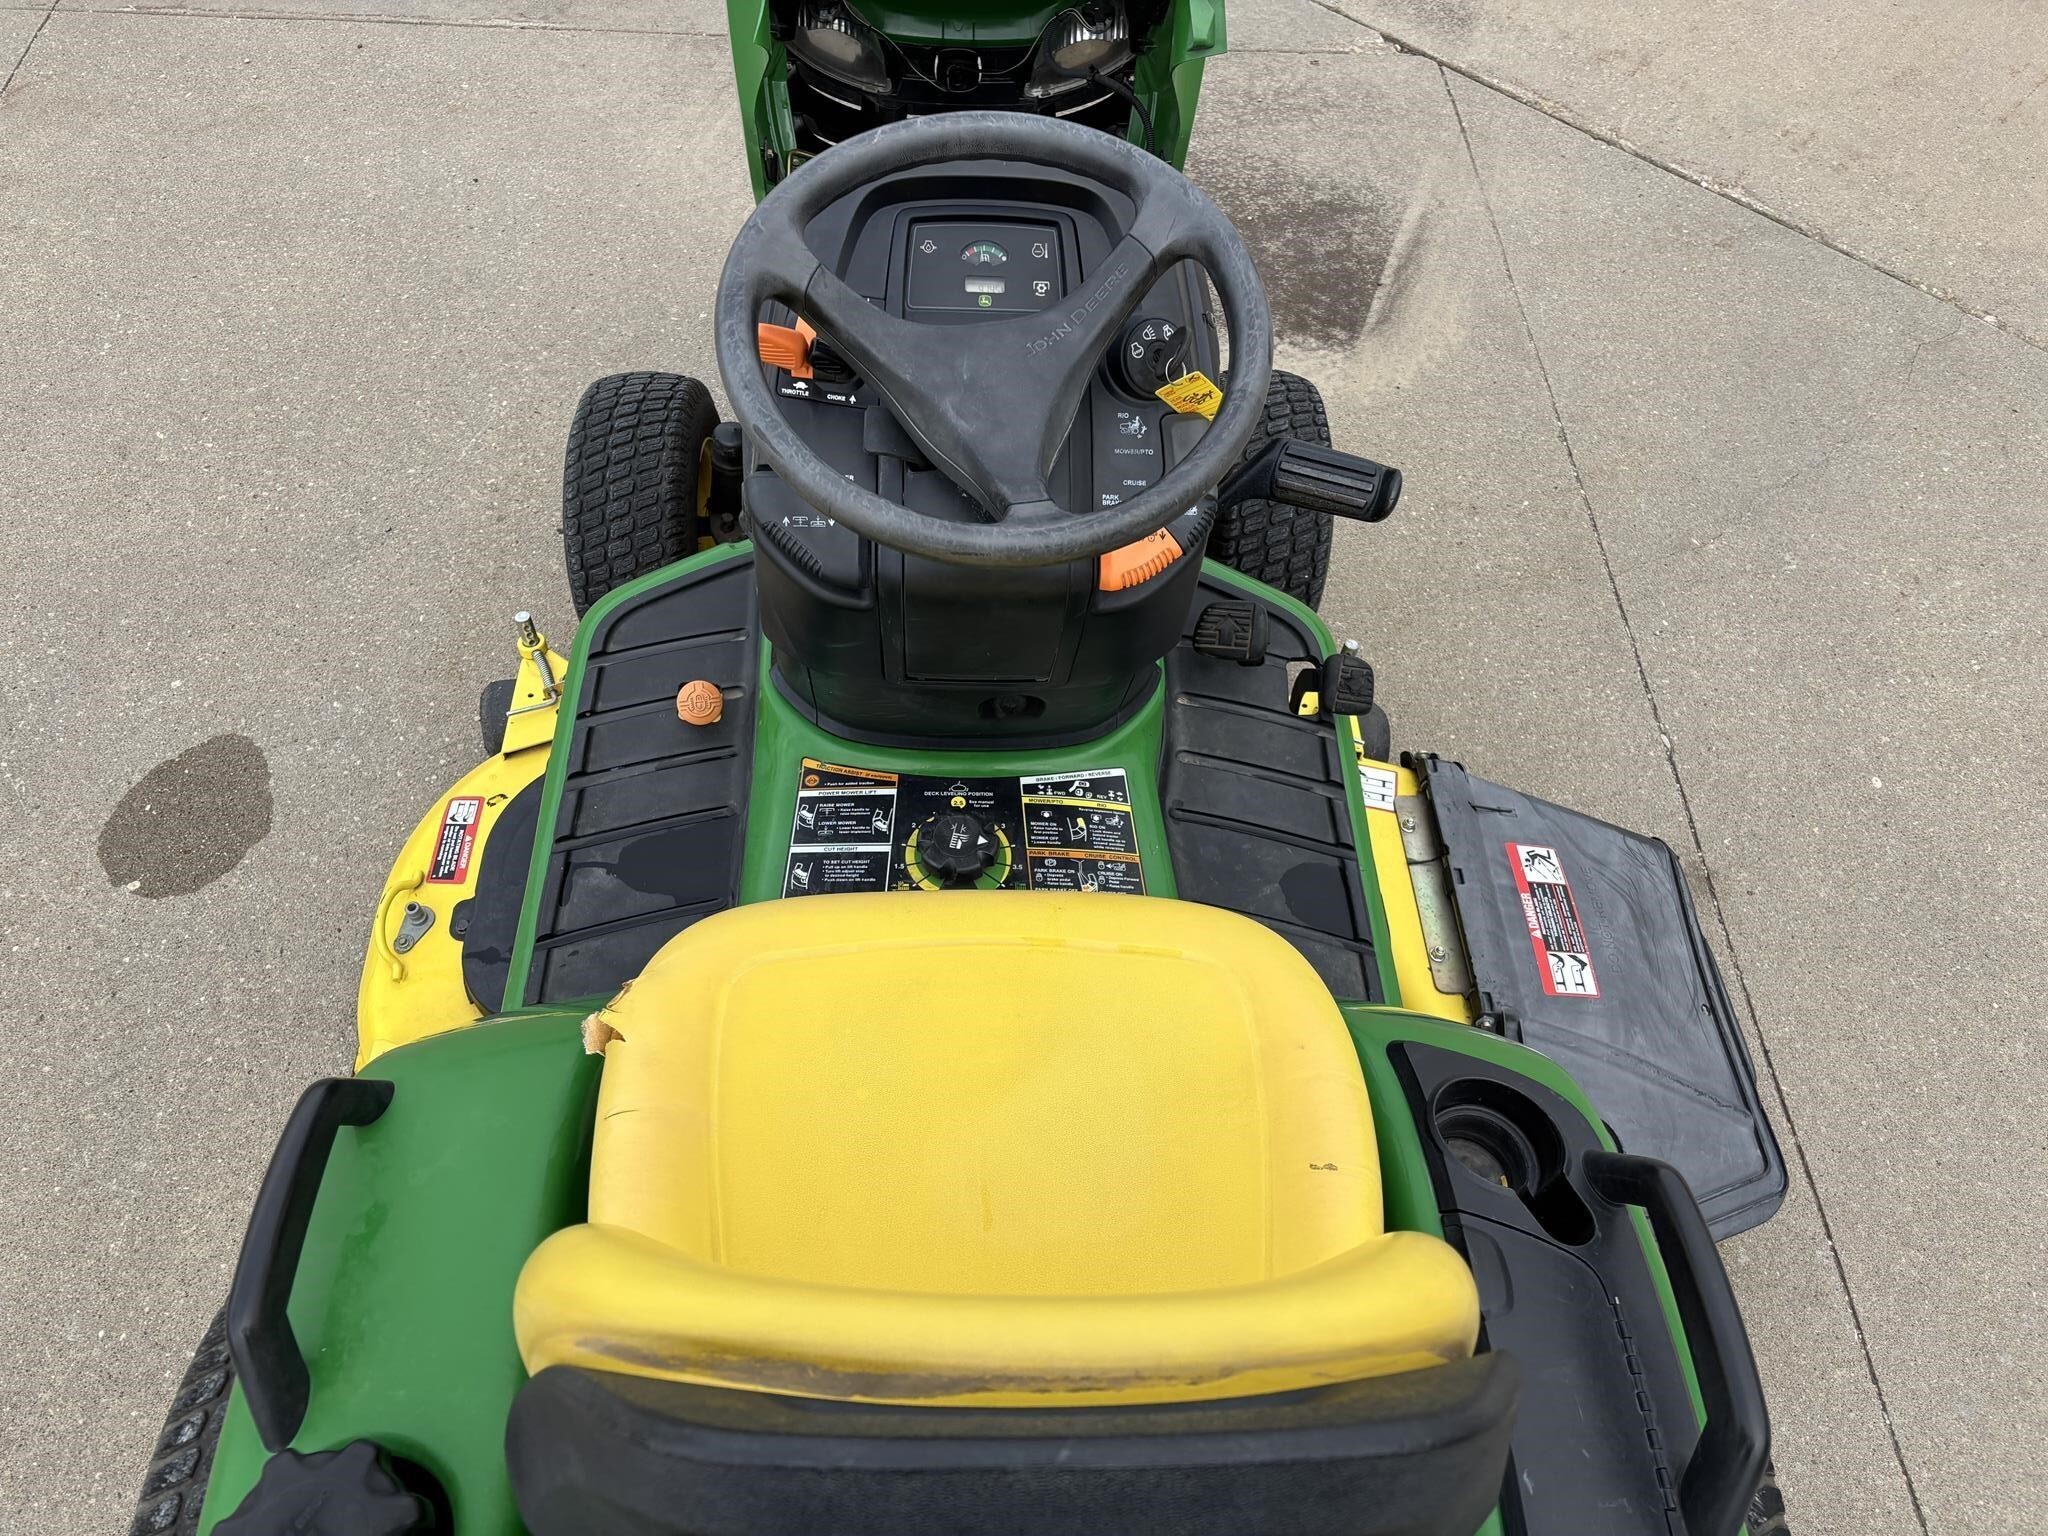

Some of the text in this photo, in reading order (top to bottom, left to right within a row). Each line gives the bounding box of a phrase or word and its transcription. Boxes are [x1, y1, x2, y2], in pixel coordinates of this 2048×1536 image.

[1070, 263, 1128, 325] DEERE
[781, 388, 809, 397] THROTTLE
[460, 842, 471, 869] DANGER
[1520, 892, 1539, 928] DANGER
